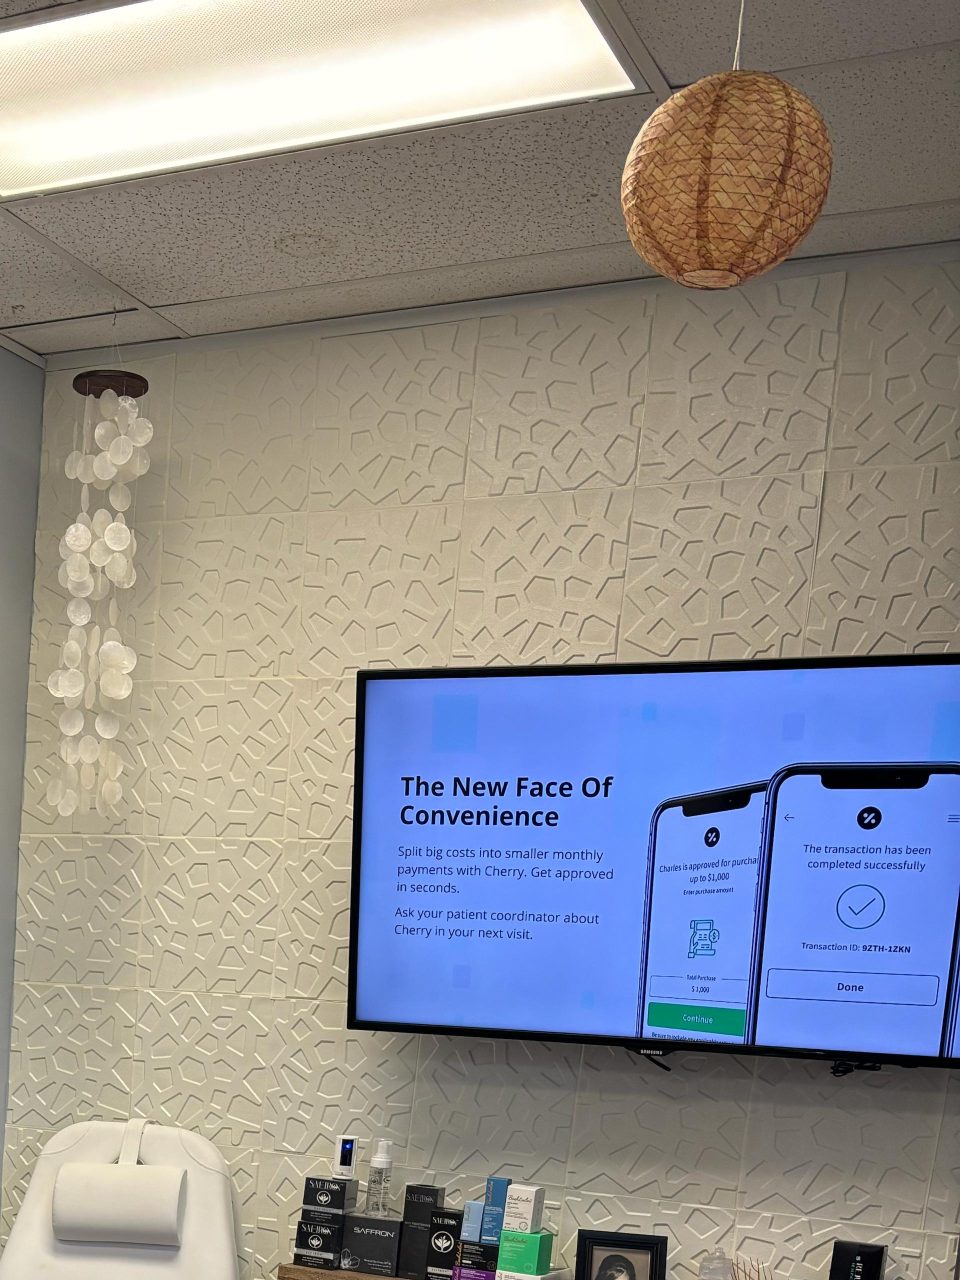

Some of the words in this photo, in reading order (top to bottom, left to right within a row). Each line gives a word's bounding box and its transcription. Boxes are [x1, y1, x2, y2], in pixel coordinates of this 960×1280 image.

[401, 776, 444, 796] The
[453, 777, 508, 797] New
[516, 777, 573, 798] Face
[582, 776, 614, 798] Of
[400, 805, 559, 826] Convenience
[398, 846, 422, 859] Split
[426, 846, 442, 860] big
[446, 848, 476, 858] costs
[479, 848, 502, 858] into
[505, 848, 549, 860] smaller
[552, 849, 604, 863] monthly
[803, 844, 822, 854] The
[824, 845, 882, 854] transaction
[884, 845, 902, 854] has
[906, 846, 932, 855] been
[659, 864, 682, 872] Charles
[682, 863, 688, 871] is
[688, 859, 720, 871] approved
[721, 859, 731, 867] for
[807, 860, 862, 870] completed
[864, 860, 926, 872] successfully
[397, 866, 453, 878] payments
[456, 865, 481, 876] with
[485, 866, 527, 880] Cherry.
[531, 867, 551, 878] Get
[555, 868, 614, 881] approved
[690, 876, 698, 884] up
[700, 874, 706, 882] to
[708, 873, 730, 882] $1,000
[397, 882, 406, 892] in
[410, 882, 460, 894] seconds.
[395, 907, 414, 918] Ask
[417, 910, 442, 920] your
[447, 909, 487, 921] patient
[490, 911, 560, 923] coordinator
[563, 913, 599, 924] about
[394, 924, 432, 937] Cherry
[436, 926, 445, 936] in
[448, 928, 474, 939] your
[478, 928, 503, 939] next
[506, 929, 533, 940] visit.
[802, 942, 847, 951] Transaction
[862, 945, 911, 953] 9ZTH-1ZKN
[837, 982, 864, 991] Done
[682, 1014, 714, 1024] Continue
[354, 1227, 395, 1238] SAFFRON
